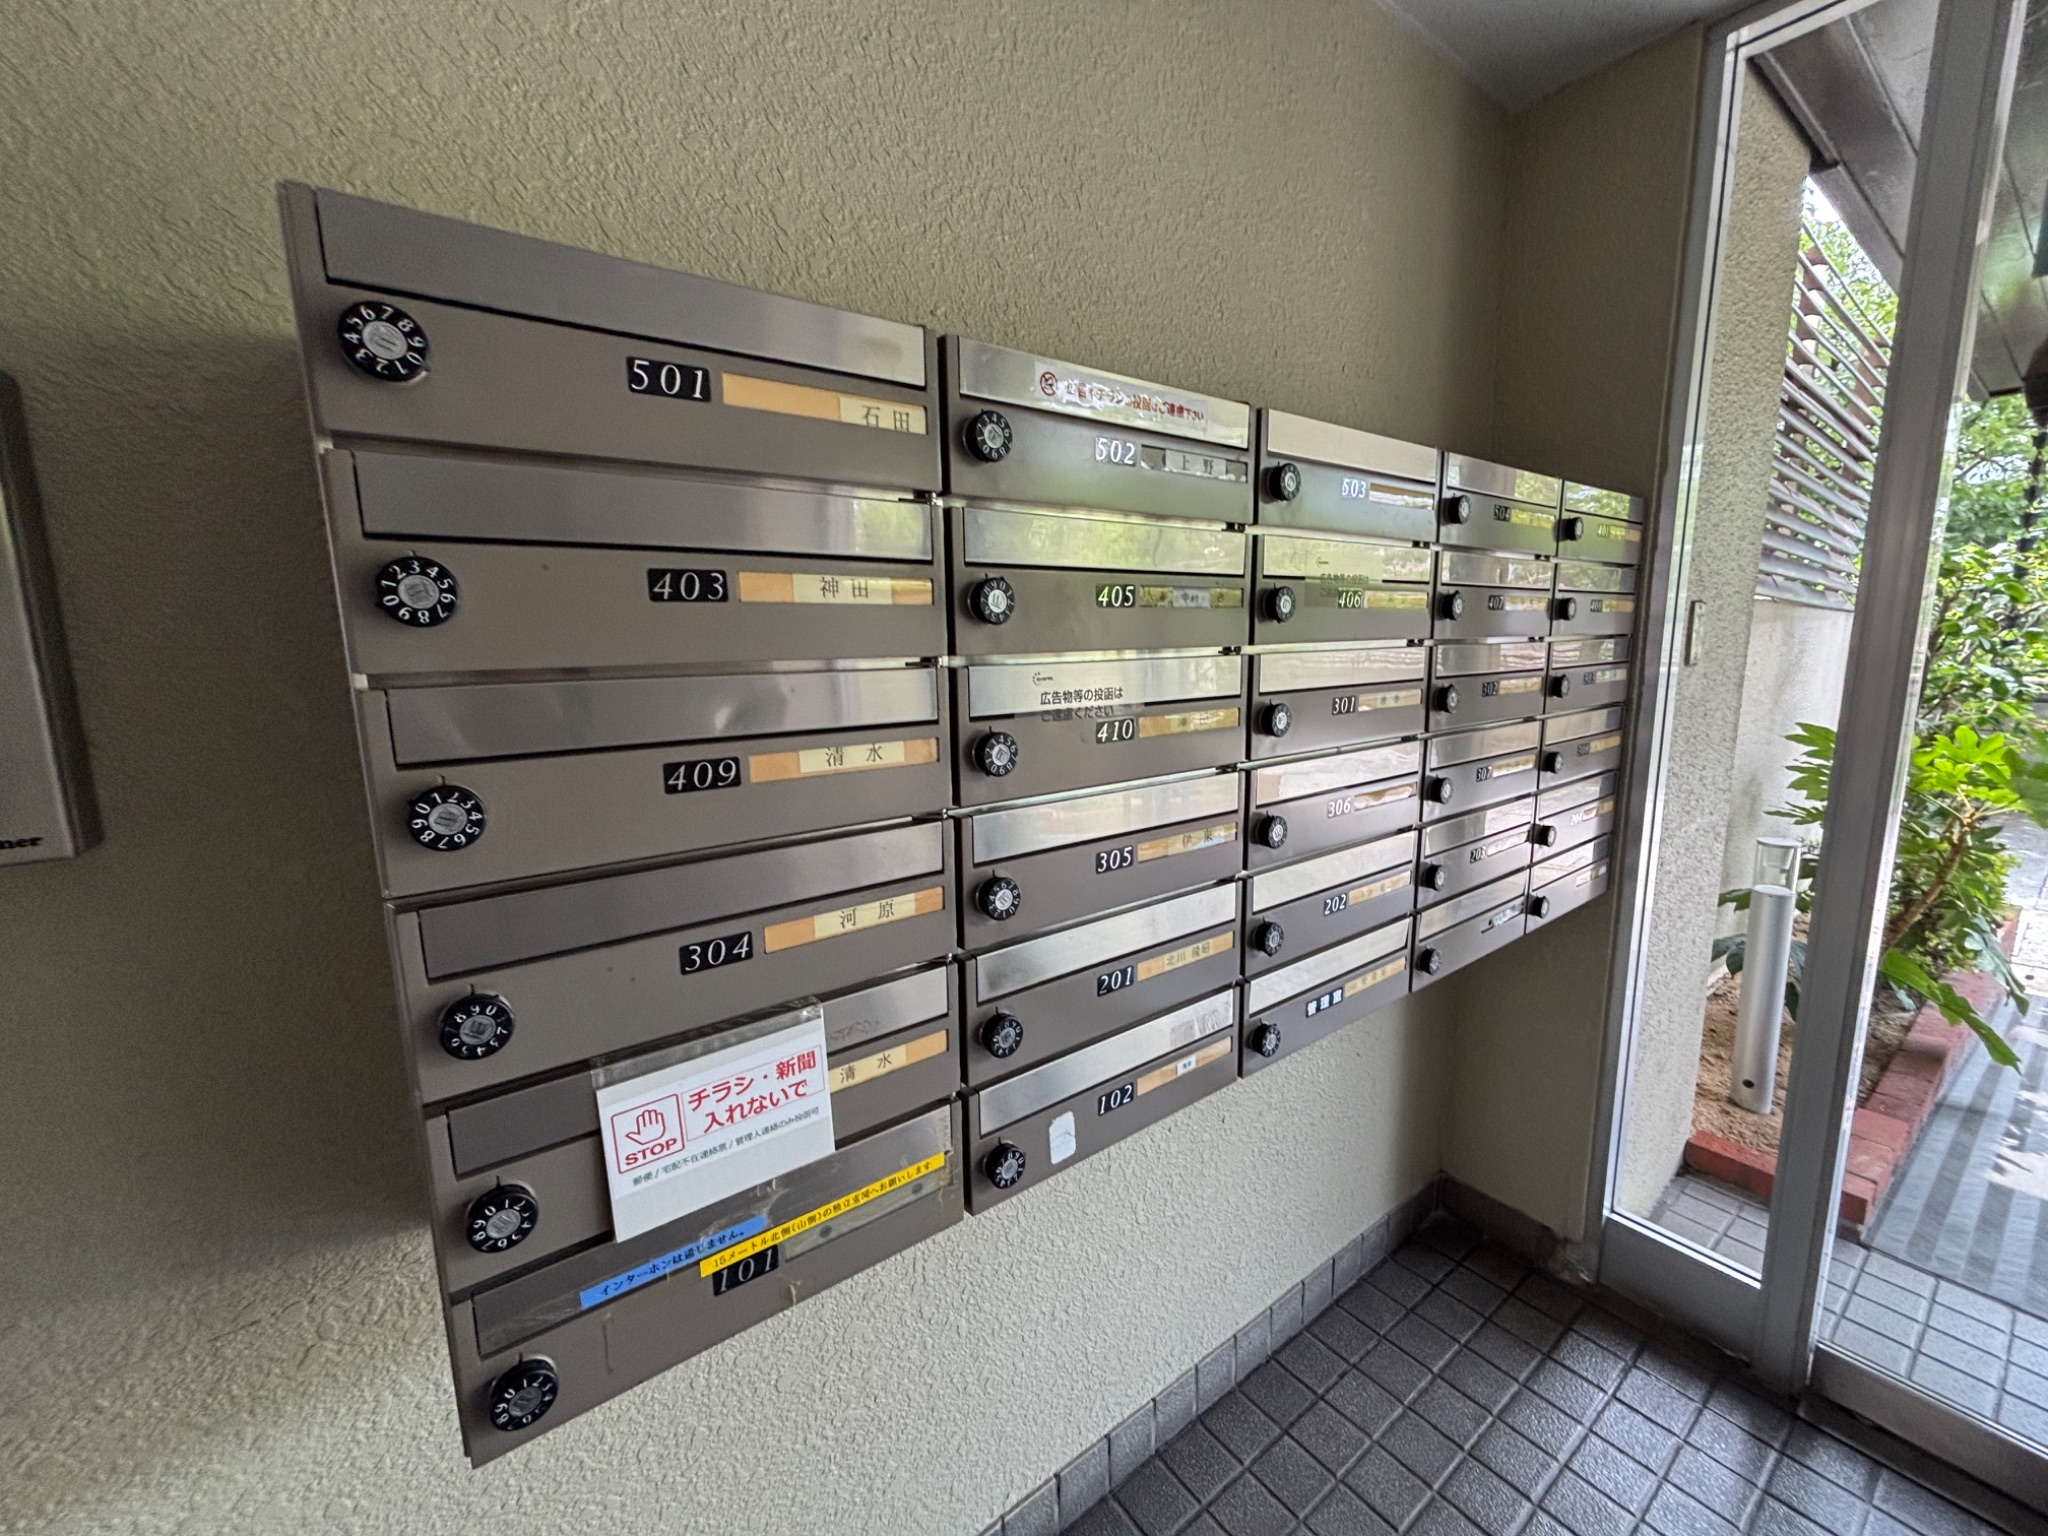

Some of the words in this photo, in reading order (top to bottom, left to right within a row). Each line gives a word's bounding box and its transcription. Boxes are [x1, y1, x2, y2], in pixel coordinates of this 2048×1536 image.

[631, 359, 703, 399] 501
[862, 405, 910, 432] 石田
[1096, 437, 1136, 465] 502
[1182, 454, 1214, 475] 上野
[1342, 478, 1366, 498] 503
[652, 572, 725, 600] 403
[819, 577, 869, 599] 神田
[1098, 585, 1135, 607] 405
[1338, 591, 1362, 608] 406
[1040, 687, 1123, 705] 広告物等の投函は
[1333, 697, 1356, 714] 301
[1097, 720, 1134, 743] 410
[825, 743, 883, 768] 清水
[667, 759, 738, 791] 409
[1328, 797, 1352, 817] 306
[1097, 846, 1133, 873] 305
[839, 900, 895, 928] 河原
[1324, 894, 1347, 915] 202
[684, 934, 750, 971] 304
[1098, 966, 1133, 995] 201
[688, 1050, 817, 1112] チラシ・新聞
[839, 1052, 893, 1084] 清水
[702, 1079, 809, 1134] 入れないで
[1099, 1084, 1133, 1115] 102
[625, 1137, 678, 1166] STOP
[720, 1248, 773, 1293] 101
